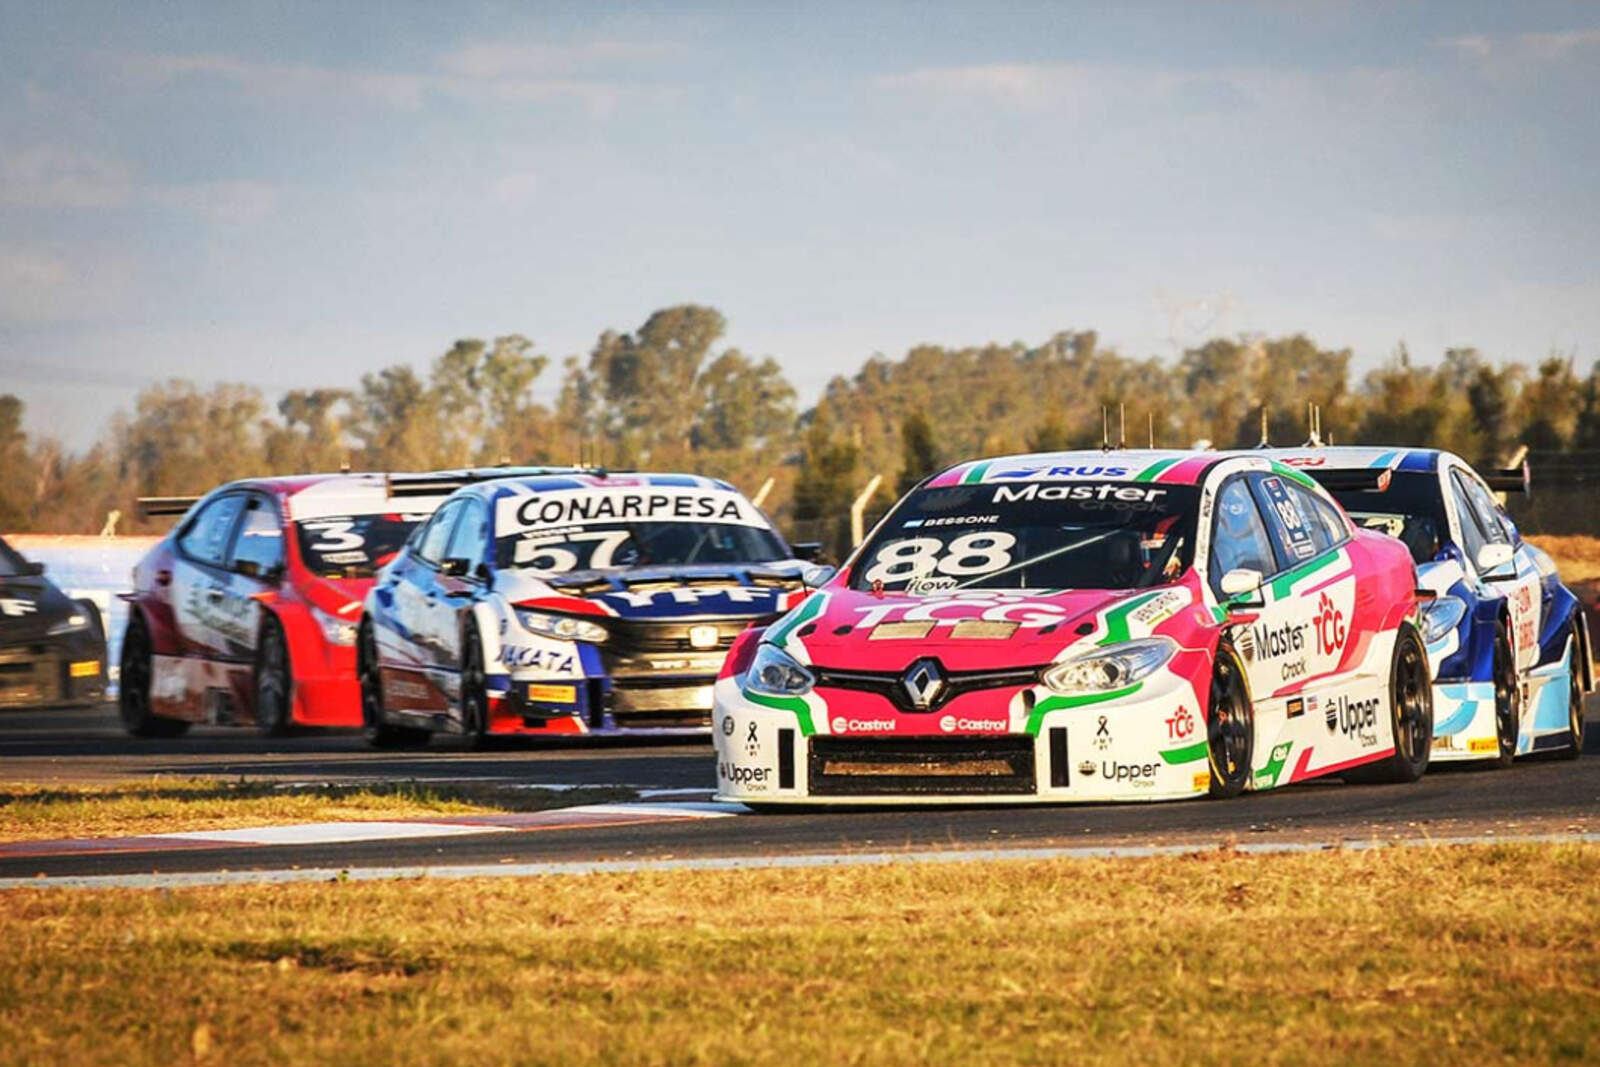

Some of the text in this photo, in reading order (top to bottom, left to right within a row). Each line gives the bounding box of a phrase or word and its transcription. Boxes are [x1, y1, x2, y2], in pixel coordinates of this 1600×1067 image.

[1047, 467, 1128, 477] RUS
[991, 484, 1167, 504] Master
[516, 495, 742, 526] CONARPESA
[923, 515, 1000, 527] BESSONE
[1276, 500, 1302, 530] 88
[302, 521, 366, 551] 3
[510, 530, 632, 574] 57
[865, 531, 1017, 585] 88
[606, 586, 771, 608] YPF
[853, 600, 1068, 630] TCG
[1253, 621, 1309, 661] Master
[1312, 608, 1345, 656] TCG
[849, 718, 896, 732] Castrol
[957, 718, 1008, 732] Castrol
[1165, 713, 1194, 739] TCG
[1339, 695, 1380, 740] Upper
[727, 761, 772, 785] Upper
[1102, 761, 1161, 783] Upper
